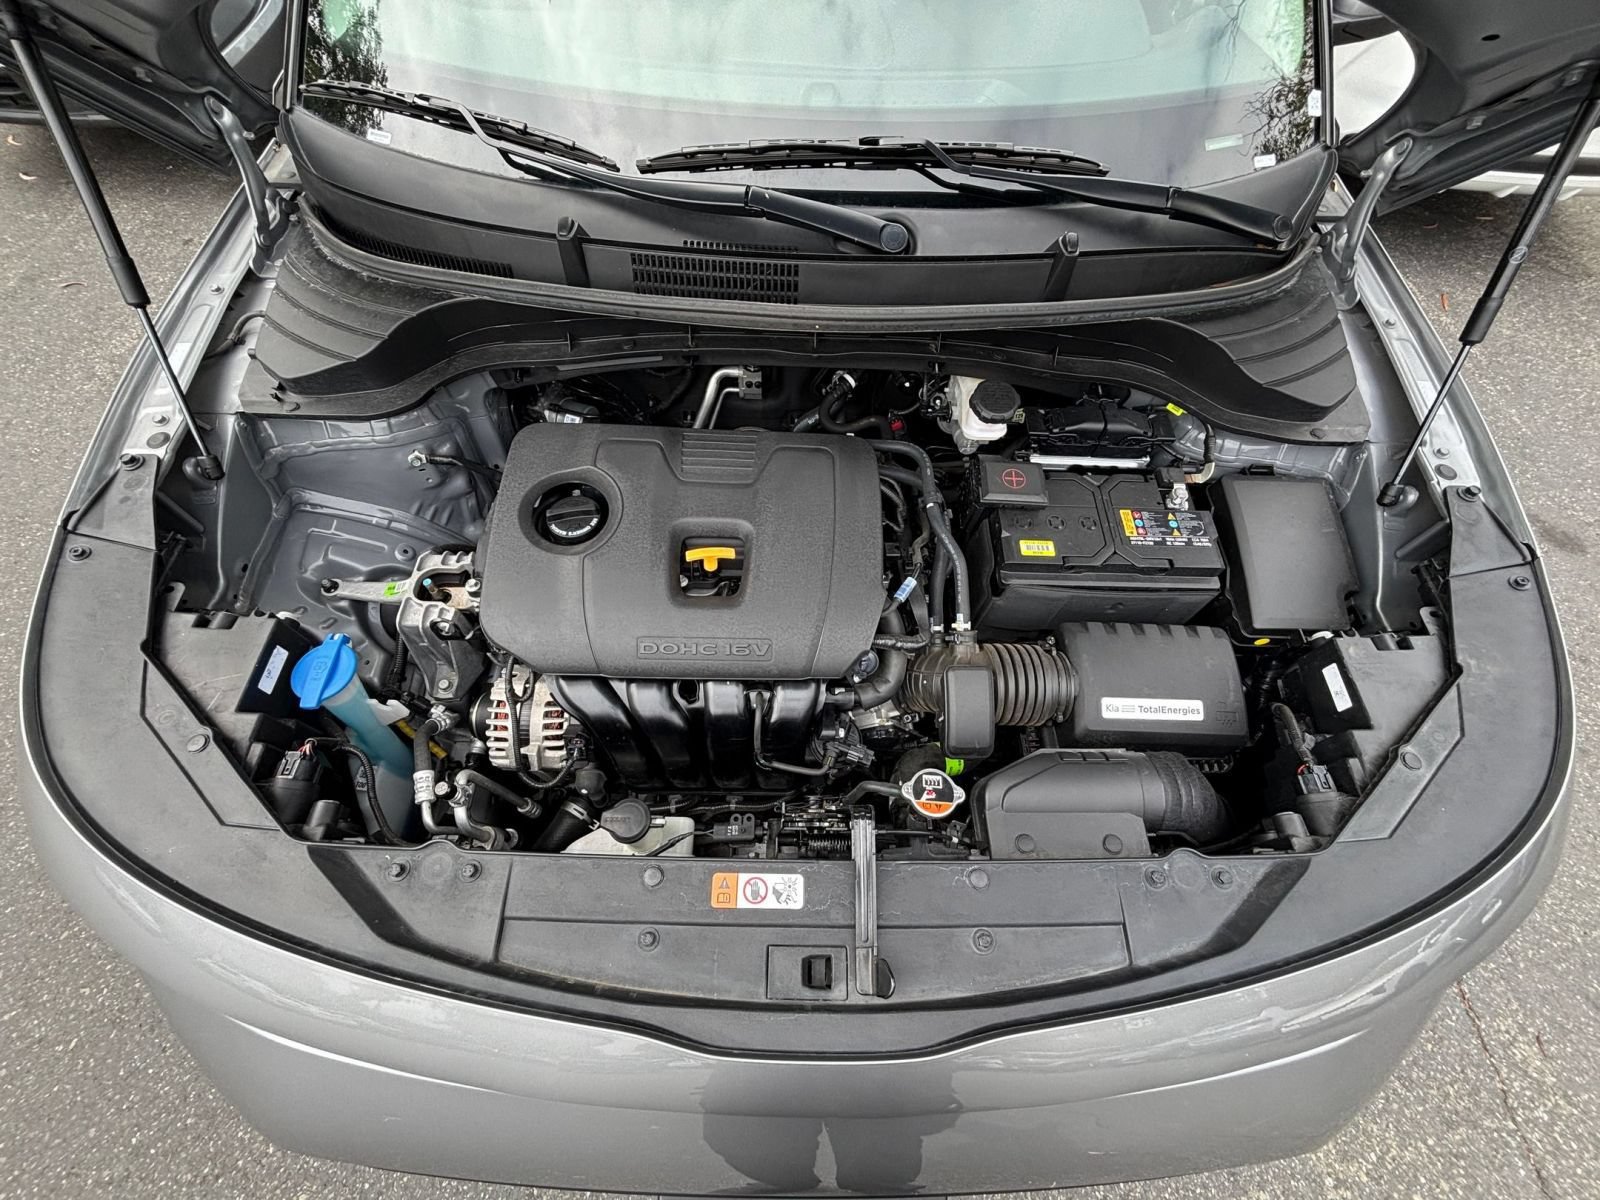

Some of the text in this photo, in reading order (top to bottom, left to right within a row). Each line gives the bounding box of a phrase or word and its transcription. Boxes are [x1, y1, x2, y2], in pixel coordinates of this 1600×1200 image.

[639, 642, 772, 657] DOHC 16V
[1105, 703, 1201, 716] Kia TotalEnergies
